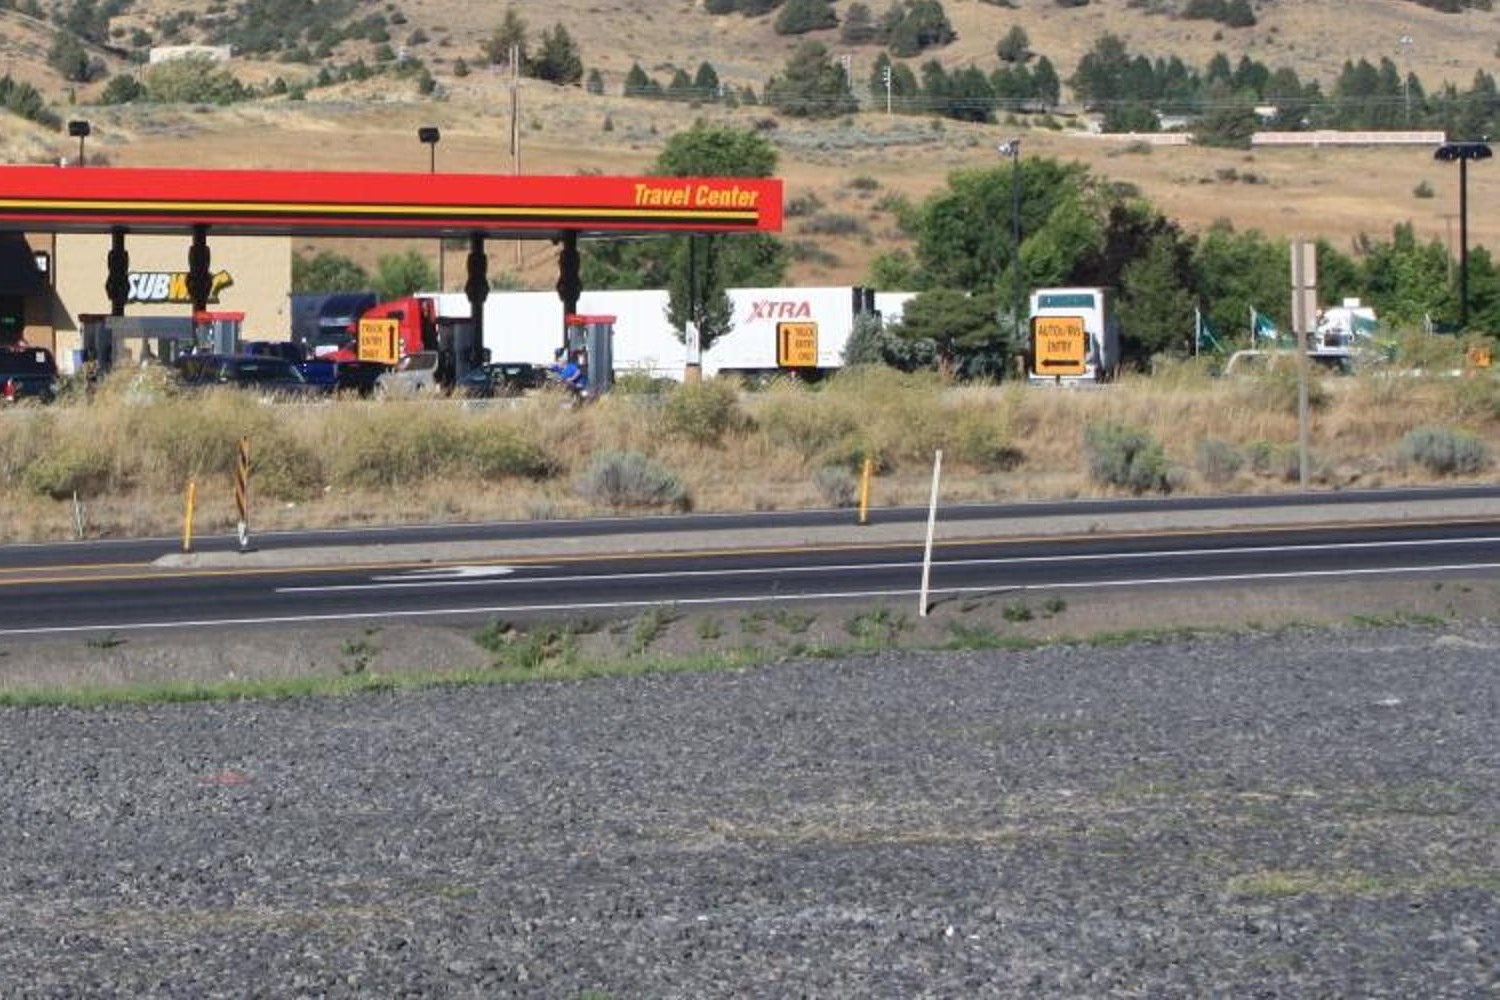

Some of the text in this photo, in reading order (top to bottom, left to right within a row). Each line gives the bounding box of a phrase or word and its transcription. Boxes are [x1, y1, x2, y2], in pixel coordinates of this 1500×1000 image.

[635, 183, 759, 208] Travel Center
[746, 300, 811, 323] XTRA
